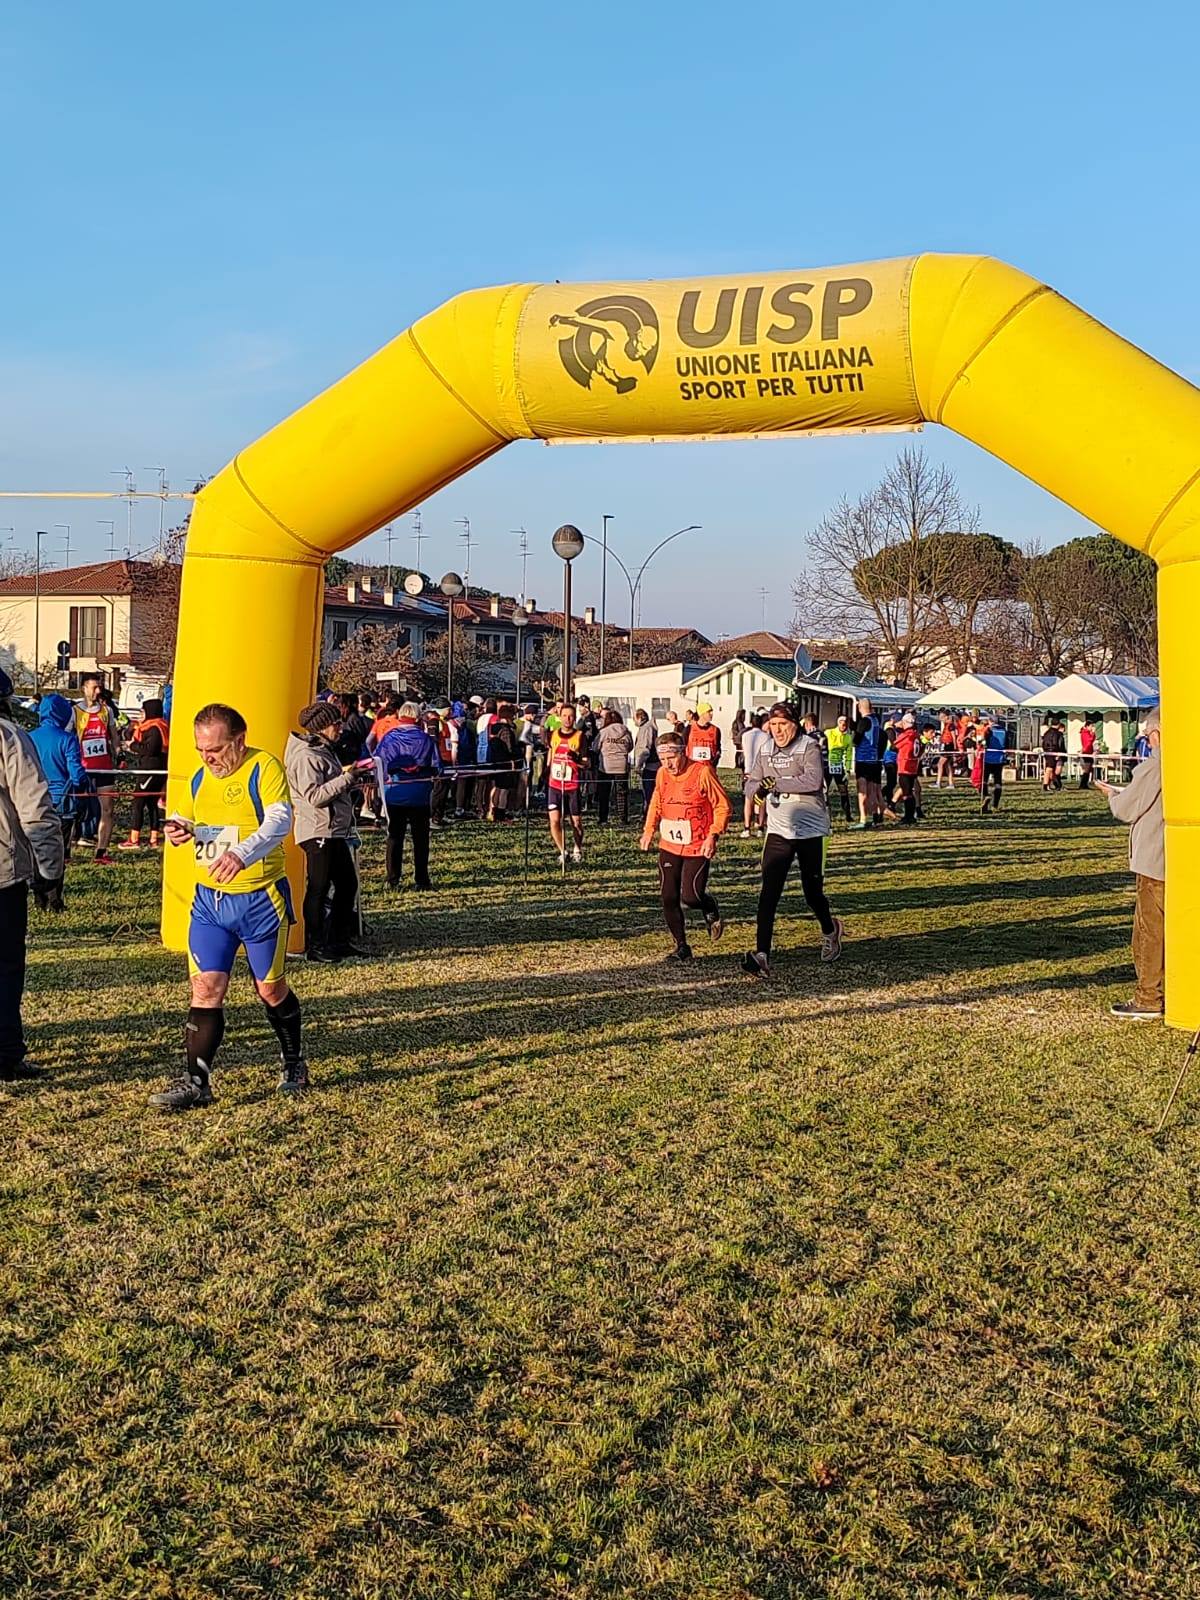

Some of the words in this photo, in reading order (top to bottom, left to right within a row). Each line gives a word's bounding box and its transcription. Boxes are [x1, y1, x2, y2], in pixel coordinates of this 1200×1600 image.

[677, 278, 873, 349] UISP
[676, 353, 761, 377] UNIONE
[771, 346, 874, 373] ITALIANA
[680, 379, 747, 401] SPORT
[757, 377, 797, 398] PER
[805, 372, 865, 395] TUTTI
[86, 744, 105, 755] 144
[669, 829, 684, 841] 14
[195, 840, 232, 860] 207
